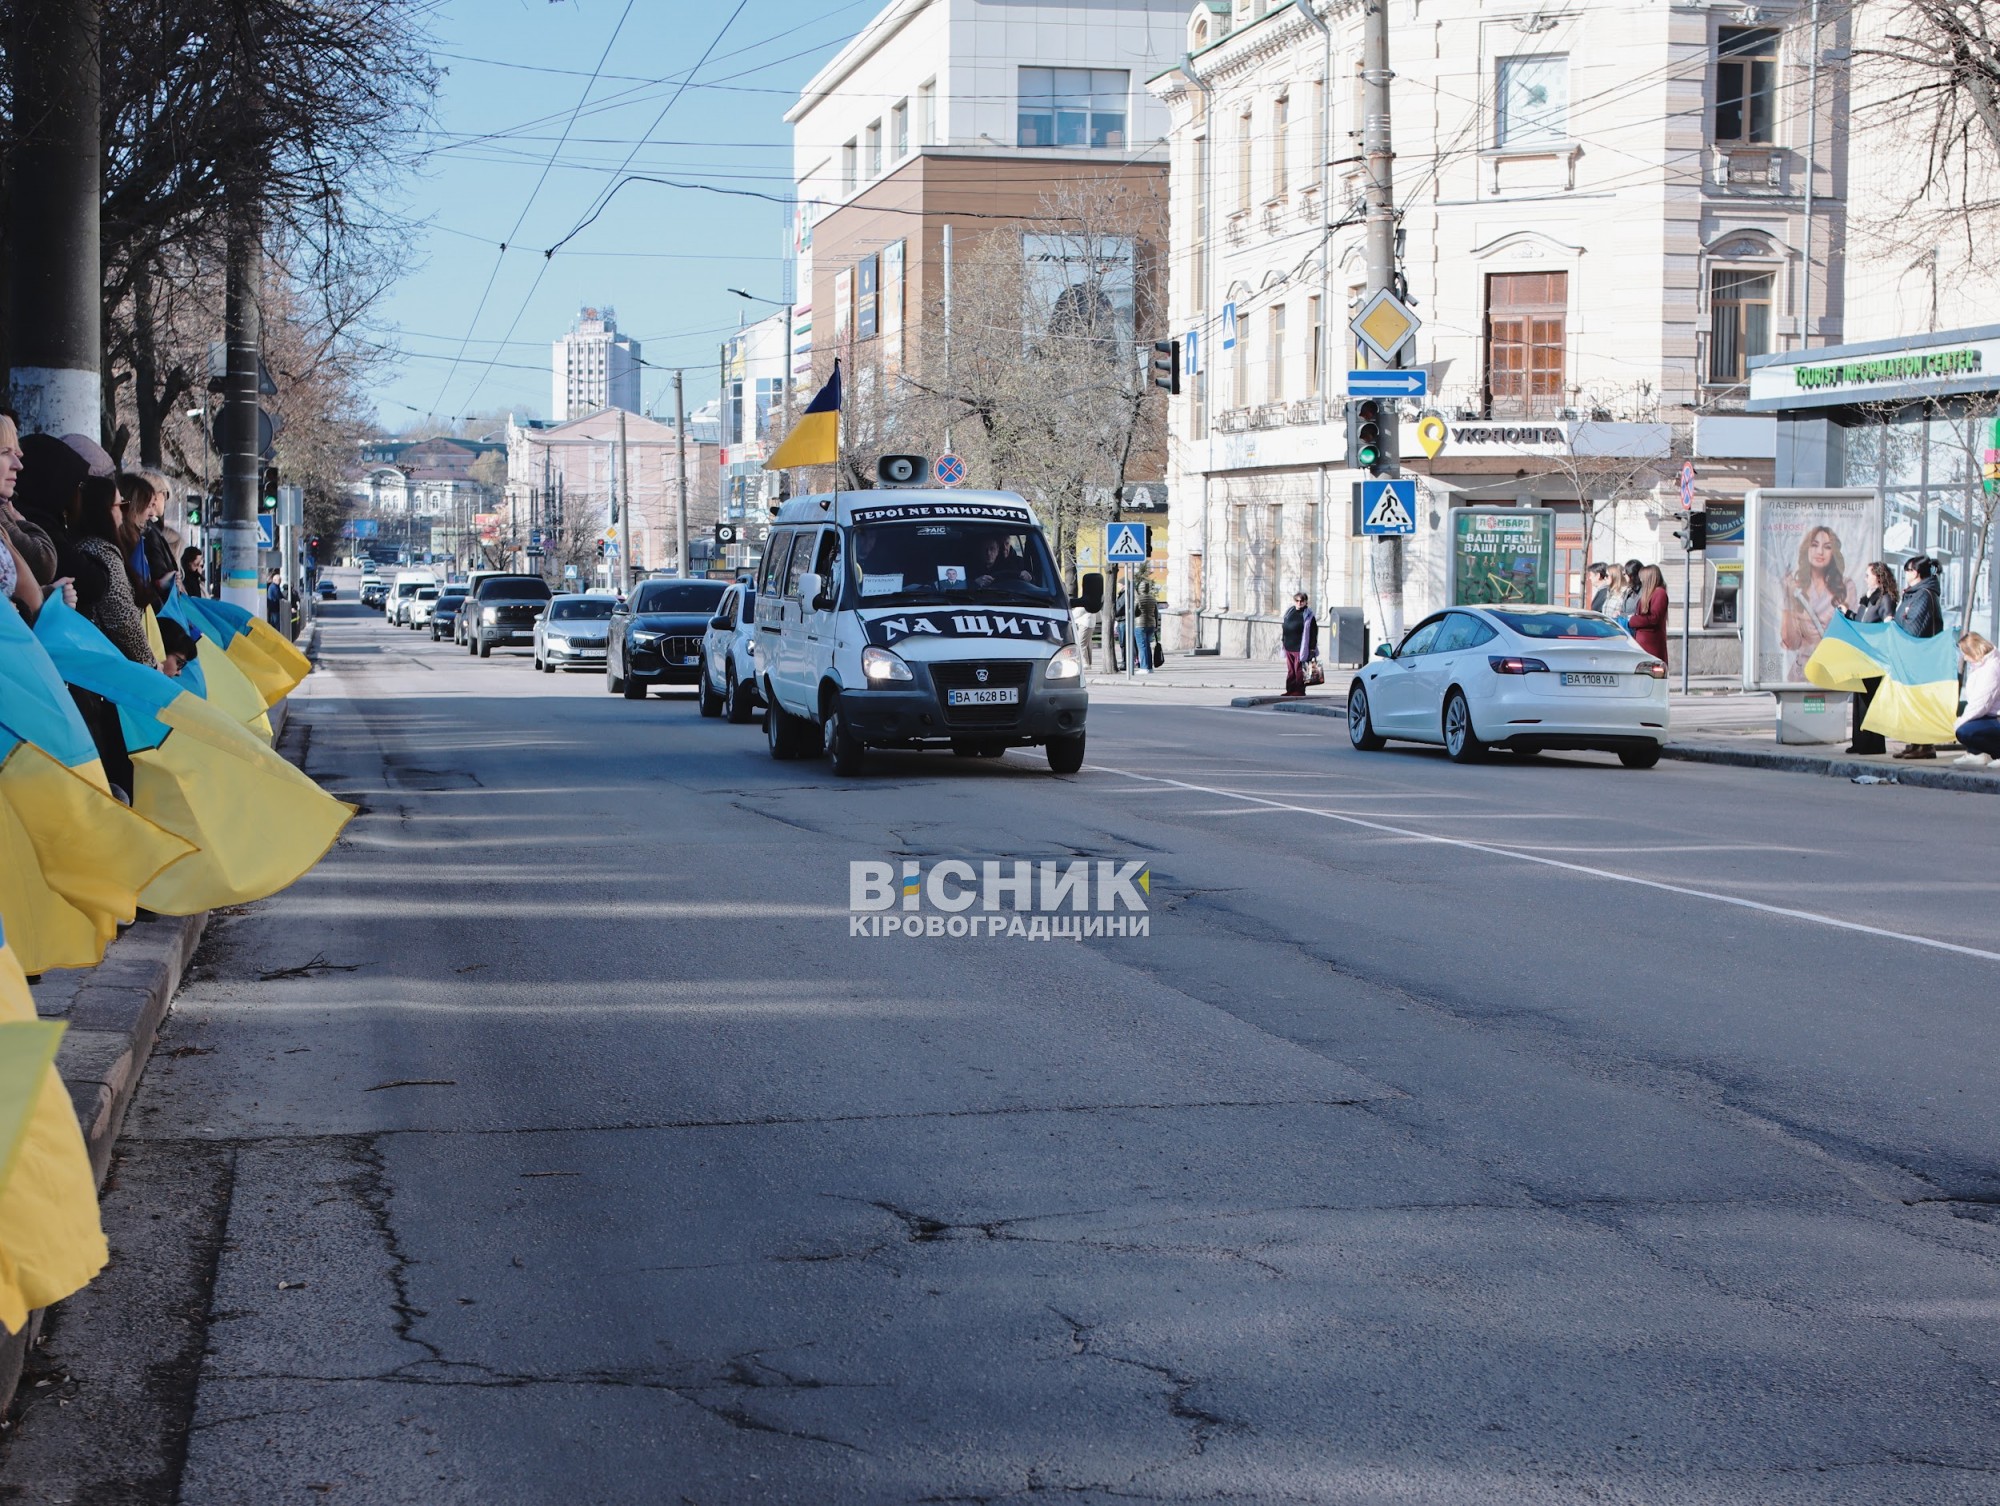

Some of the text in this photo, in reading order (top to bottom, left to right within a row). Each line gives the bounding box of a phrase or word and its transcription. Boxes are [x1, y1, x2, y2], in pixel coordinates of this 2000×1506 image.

[1793, 350, 1974, 386] TOURIST INFORMATION CENTER
[1451, 427, 1566, 444] УКРПОШТА
[935, 505, 1028, 520] ВМИРАЮТЬ
[1768, 501, 1865, 512] ЛАЗЕРНА ЕПІЛЯЦІЯ
[1479, 516, 1531, 529] ЛОМБАРД
[1466, 533, 1499, 543] ВАШІ
[1464, 543, 1542, 554] ВАШІ ГРОШІ
[951, 615, 1064, 641] ЩИТІ
[1567, 674, 1580, 684] BA
[1582, 674, 1601, 684] 1108
[955, 692, 970, 703] BA
[975, 690, 997, 702] 1628
